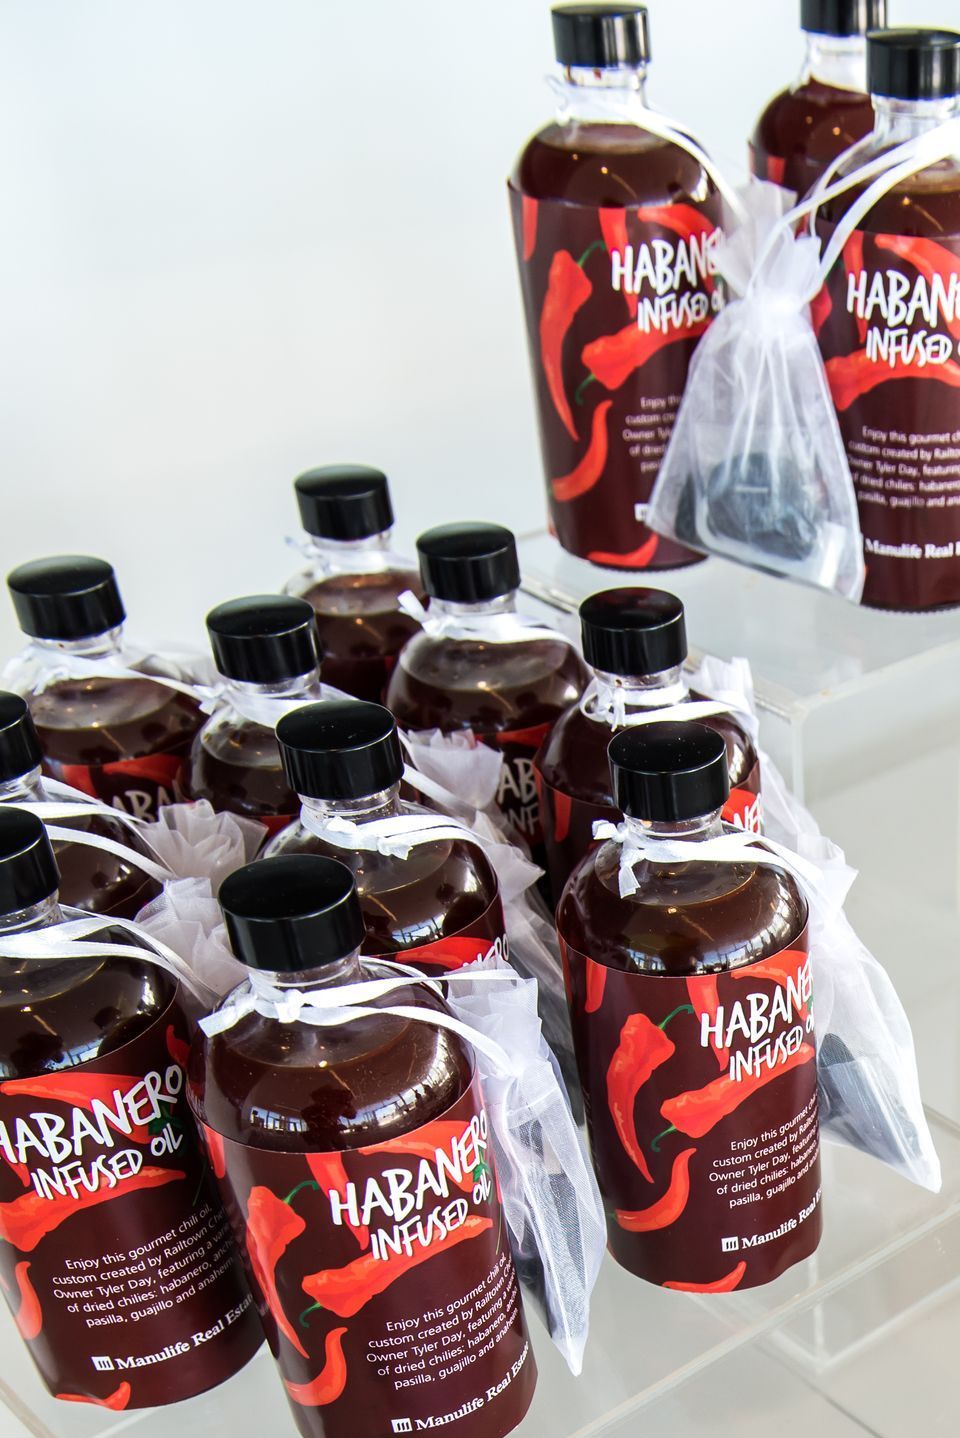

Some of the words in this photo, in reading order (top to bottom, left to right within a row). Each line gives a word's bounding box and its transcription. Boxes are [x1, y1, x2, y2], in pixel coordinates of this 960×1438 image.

[637, 291, 709, 335] INFUSED
[866, 326, 953, 368] INFUSED
[919, 448, 932, 462] by
[926, 495, 946, 507] and
[865, 537, 922, 559] Manulife
[924, 542, 953, 559] Real
[729, 1025, 804, 1082] INFUSED
[712, 1154, 752, 1168] custom
[754, 1140, 788, 1159] created
[789, 1129, 799, 1145] by
[730, 1136, 758, 1151] Enjoy
[761, 1128, 777, 1143] this
[779, 1106, 808, 1133] gourmet
[31, 1149, 143, 1200] INFUSED
[150, 1122, 183, 1157] OIL
[328, 1109, 488, 1227] HABANERO
[708, 1168, 745, 1182] Owner
[747, 1159, 769, 1176] Tyler
[772, 1150, 791, 1167] Day,
[716, 1183, 728, 1195] of
[731, 1177, 758, 1193] dried
[760, 1166, 789, 1184] chilies:
[729, 1192, 764, 1209] pasilla,
[766, 1176, 796, 1199] guajillo
[796, 1162, 809, 1179] and
[65, 1257, 100, 1271] Enjoy
[102, 1252, 126, 1266] this
[128, 1228, 177, 1260] gourmet
[178, 1214, 199, 1234] chili
[199, 1204, 213, 1219] oil,
[370, 1198, 469, 1261] INFUSED
[472, 1168, 492, 1205] OIL
[741, 1217, 798, 1250] Manulife
[798, 1199, 816, 1225] Real
[52, 1274, 98, 1286] custom
[100, 1261, 146, 1281] created
[149, 1256, 162, 1274] by
[163, 1226, 208, 1259] Railtown
[53, 1288, 94, 1300] Owner
[96, 1282, 125, 1299] Tyler
[128, 1275, 157, 1291] Day,
[158, 1246, 205, 1279] featuring
[206, 1241, 213, 1250] a
[67, 1302, 79, 1314] of
[83, 1299, 115, 1313] dried
[117, 1289, 158, 1308] chilies:
[160, 1261, 213, 1294] habanero,
[86, 1313, 128, 1329] pasilla,
[130, 1299, 174, 1322] guajillo
[176, 1286, 197, 1304] and
[197, 1257, 234, 1291] anaheim
[368, 1335, 414, 1349] custom
[417, 1318, 460, 1340] created
[461, 1309, 474, 1324] by
[475, 1276, 505, 1312] Railtown
[386, 1316, 420, 1333] Enjoy
[423, 1307, 444, 1324] this
[446, 1282, 486, 1315] gourmet
[487, 1262, 499, 1284] chili
[114, 1340, 191, 1370] Manulife
[190, 1319, 226, 1348] Real
[366, 1350, 408, 1363] Owner
[411, 1341, 439, 1356] Tyler
[441, 1330, 466, 1347] Day,
[467, 1297, 503, 1333] featuring
[377, 1365, 390, 1377] of
[394, 1361, 426, 1375] dried
[429, 1345, 465, 1367] chilies:
[467, 1312, 507, 1349] habanero,
[393, 1374, 436, 1391] pasilla,
[438, 1354, 477, 1380] guajillo
[478, 1337, 495, 1358] and
[495, 1307, 519, 1343] anaheim
[414, 1396, 485, 1431] Manulife
[485, 1372, 511, 1402] Real
